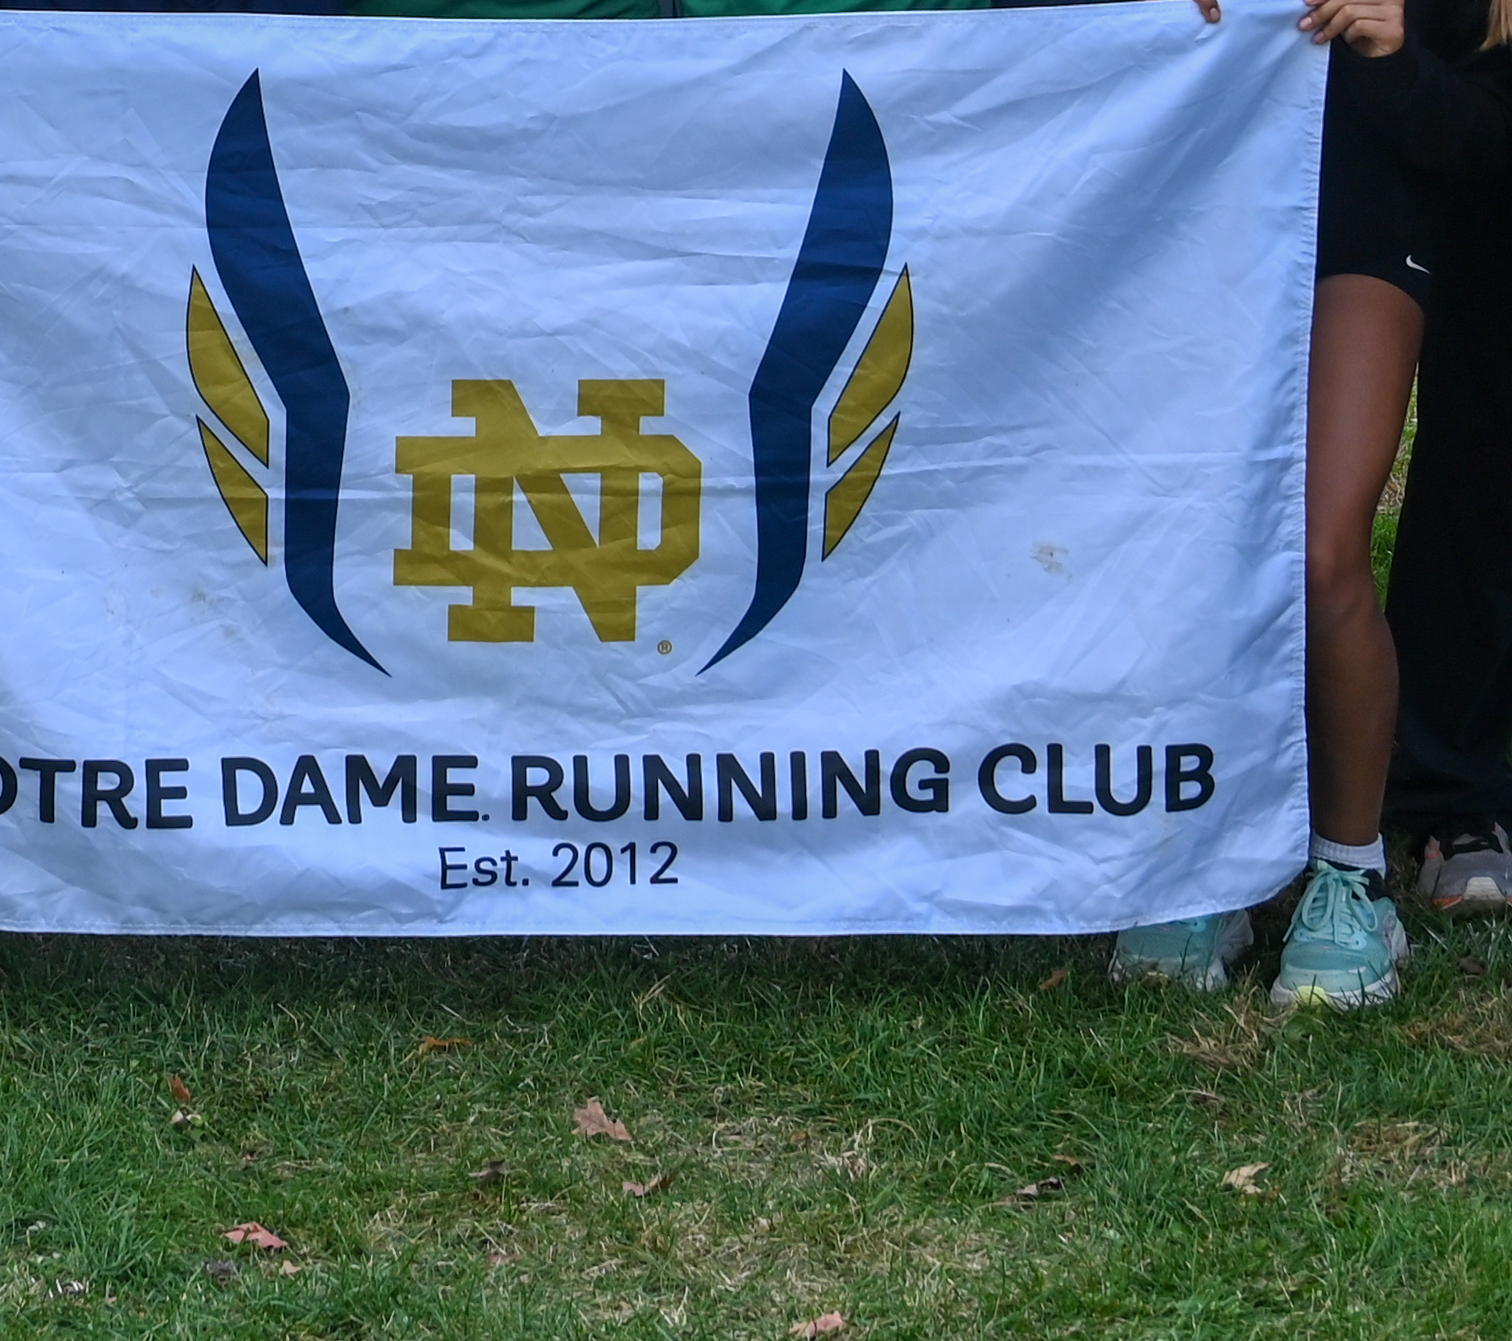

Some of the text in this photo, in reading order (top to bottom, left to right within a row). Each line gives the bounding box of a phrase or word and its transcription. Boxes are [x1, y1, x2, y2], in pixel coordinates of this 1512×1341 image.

[510, 748, 951, 824] RUNNING
[977, 742, 1216, 817] CLUB
[437, 840, 679, 891] Est. 2012
